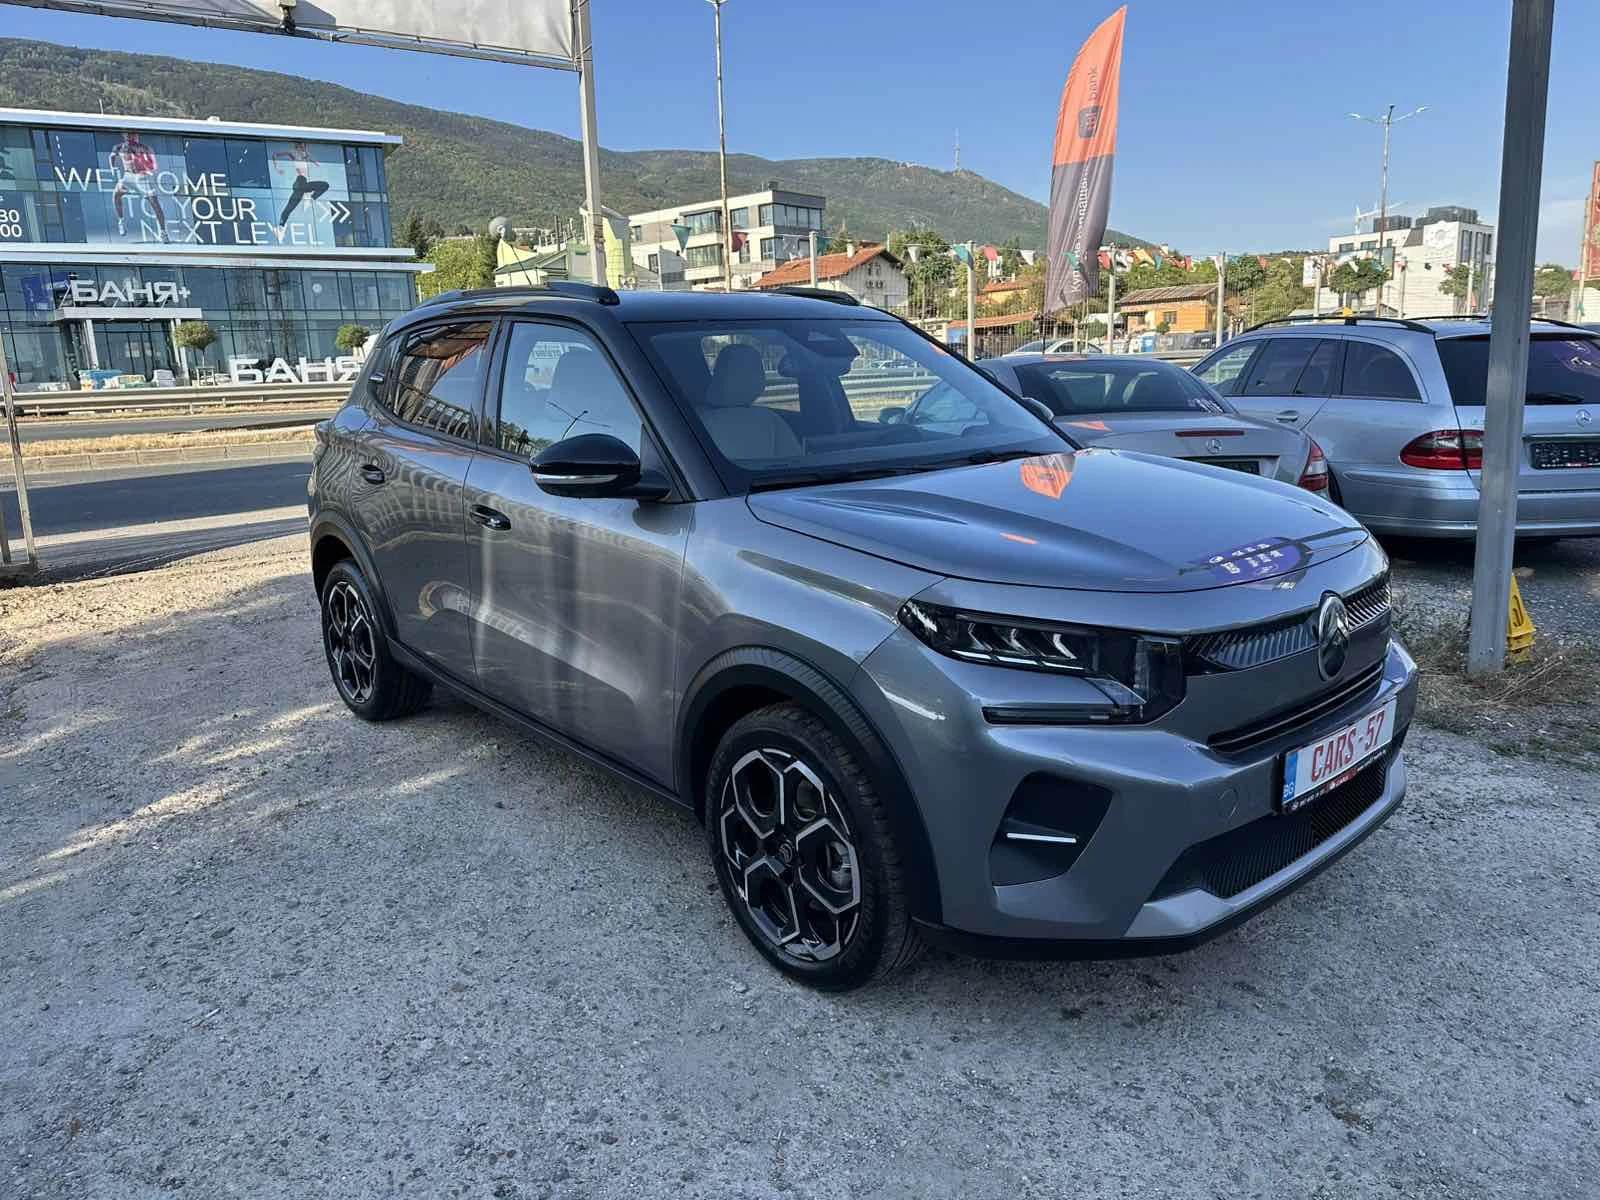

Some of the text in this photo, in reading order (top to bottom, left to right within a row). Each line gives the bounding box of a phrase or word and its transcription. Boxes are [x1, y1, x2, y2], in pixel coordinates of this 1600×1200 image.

[171, 196, 258, 221] YOUR
[140, 219, 325, 245] NEXT LEVEL
